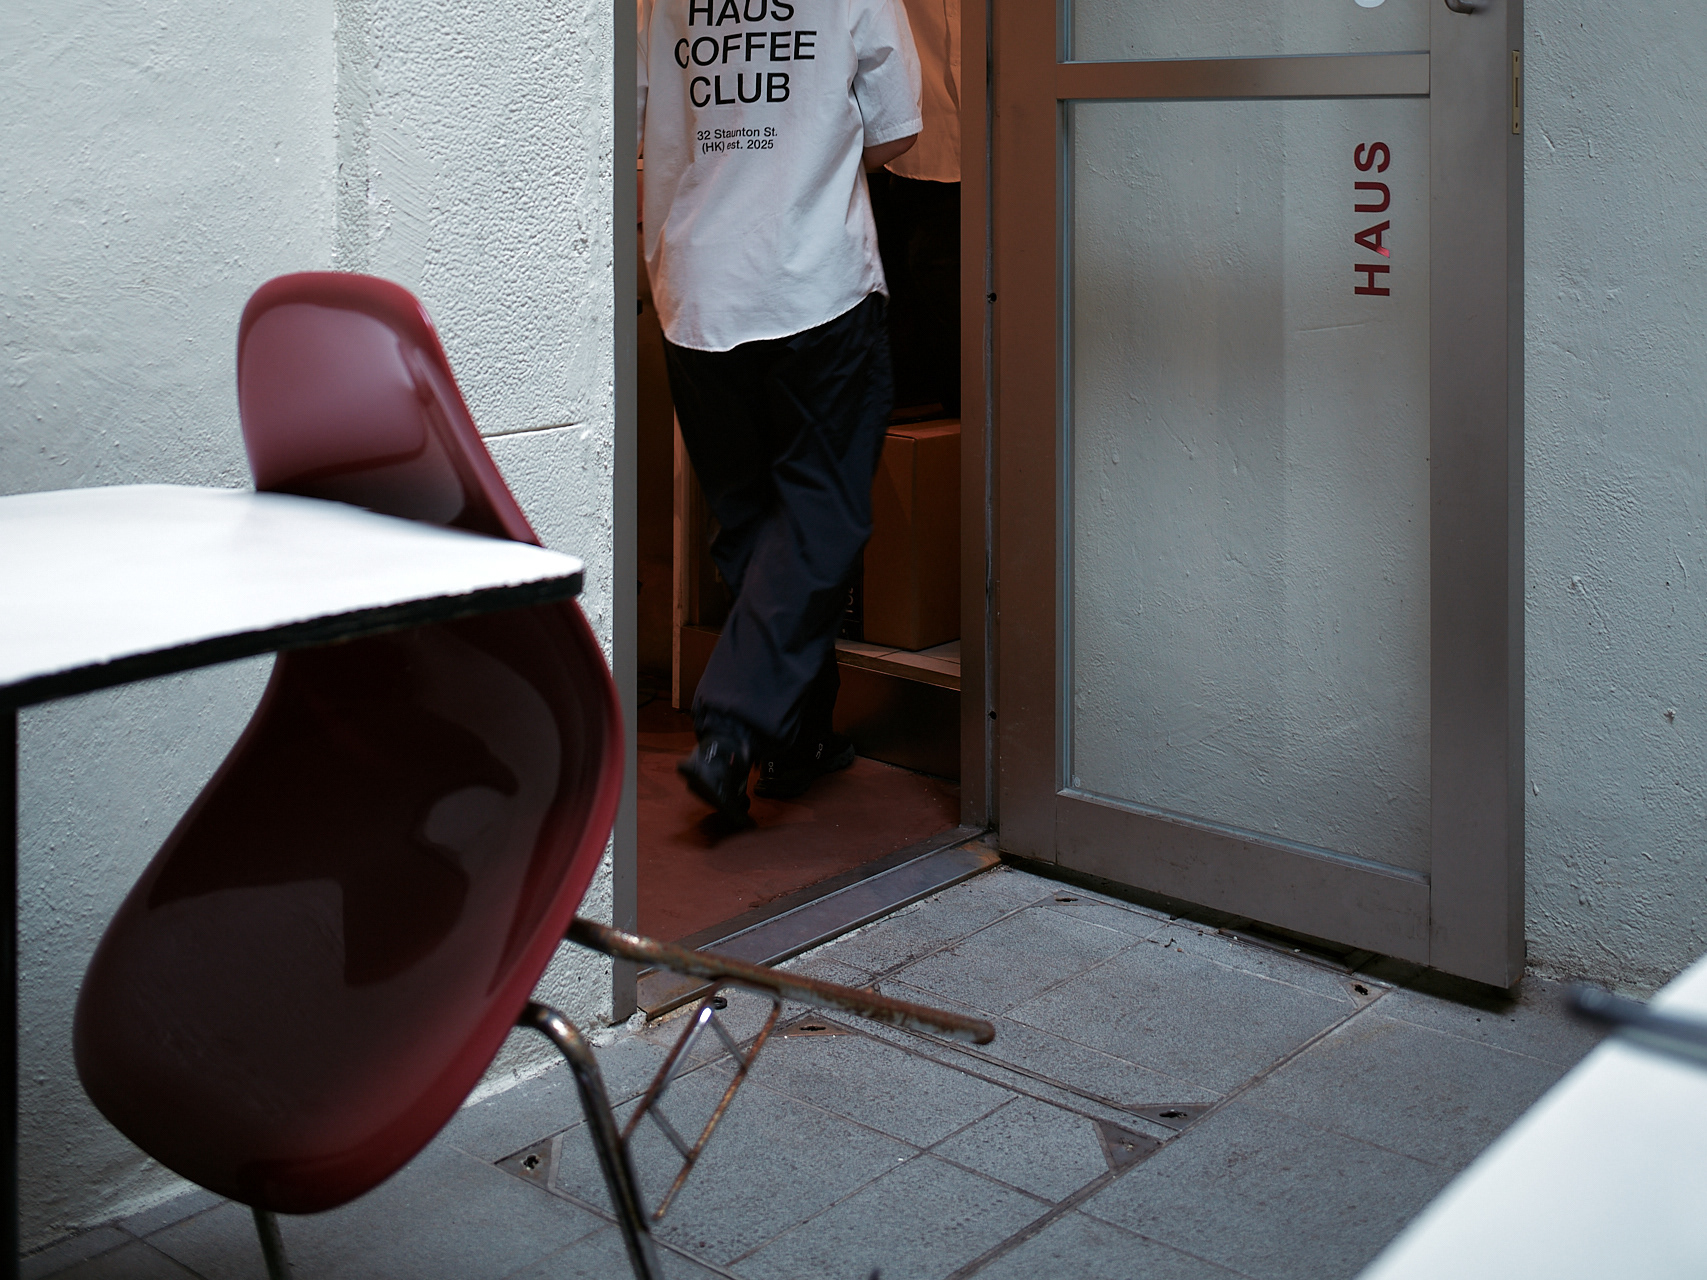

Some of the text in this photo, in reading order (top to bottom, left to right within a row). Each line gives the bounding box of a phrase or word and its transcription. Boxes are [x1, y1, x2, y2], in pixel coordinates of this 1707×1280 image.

[674, 30, 817, 69] COFFEE
[689, 72, 790, 108] CLUB
[697, 126, 778, 141] 32 Staunton St.
[702, 139, 774, 155] (HK) est. 2025
[1354, 141, 1391, 297] HAUS
